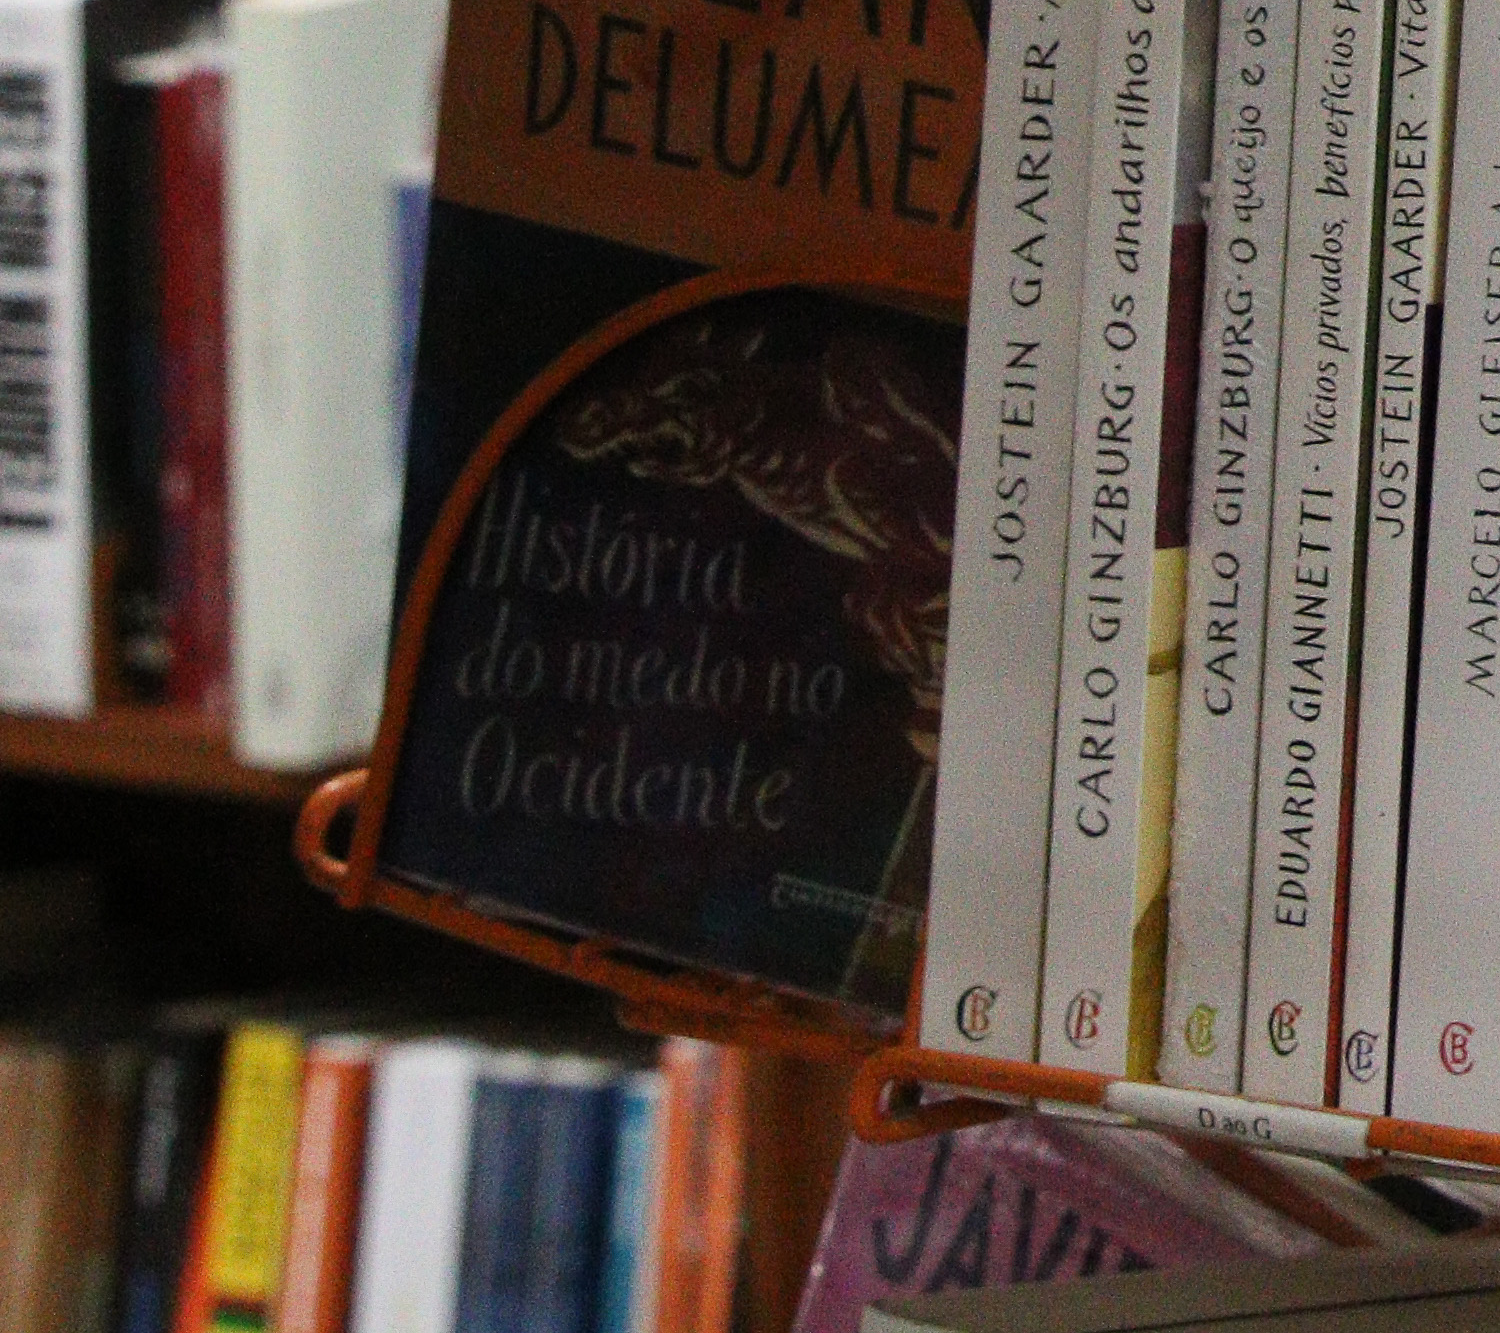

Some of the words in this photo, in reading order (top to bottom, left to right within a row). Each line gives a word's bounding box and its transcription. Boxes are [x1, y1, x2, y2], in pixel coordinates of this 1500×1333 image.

[1244, 6, 1270, 48] os
[1244, 64, 1265, 88] e
[1012, 41, 1059, 311] GAARDER
[1111, 41, 1154, 272] andarilhos
[1235, 101, 1267, 225] queijo
[1314, 38, 1357, 202] benefícios
[1234, 235, 1258, 265] O
[1388, 115, 1427, 325] GAARDER
[1103, 291, 1138, 351] Os
[1214, 288, 1253, 528] GINZBURG
[1303, 358, 1337, 451] Vícios
[993, 341, 1037, 583] JOSTEIN
[1088, 380, 1135, 644] GINZBURG
[1372, 351, 1418, 540] JOSTEIN
[1204, 548, 1240, 717] CARLO
[1290, 486, 1336, 724] GIANNETTI
[1077, 665, 1120, 840] CARLO
[1275, 738, 1317, 928] EDUARDO
